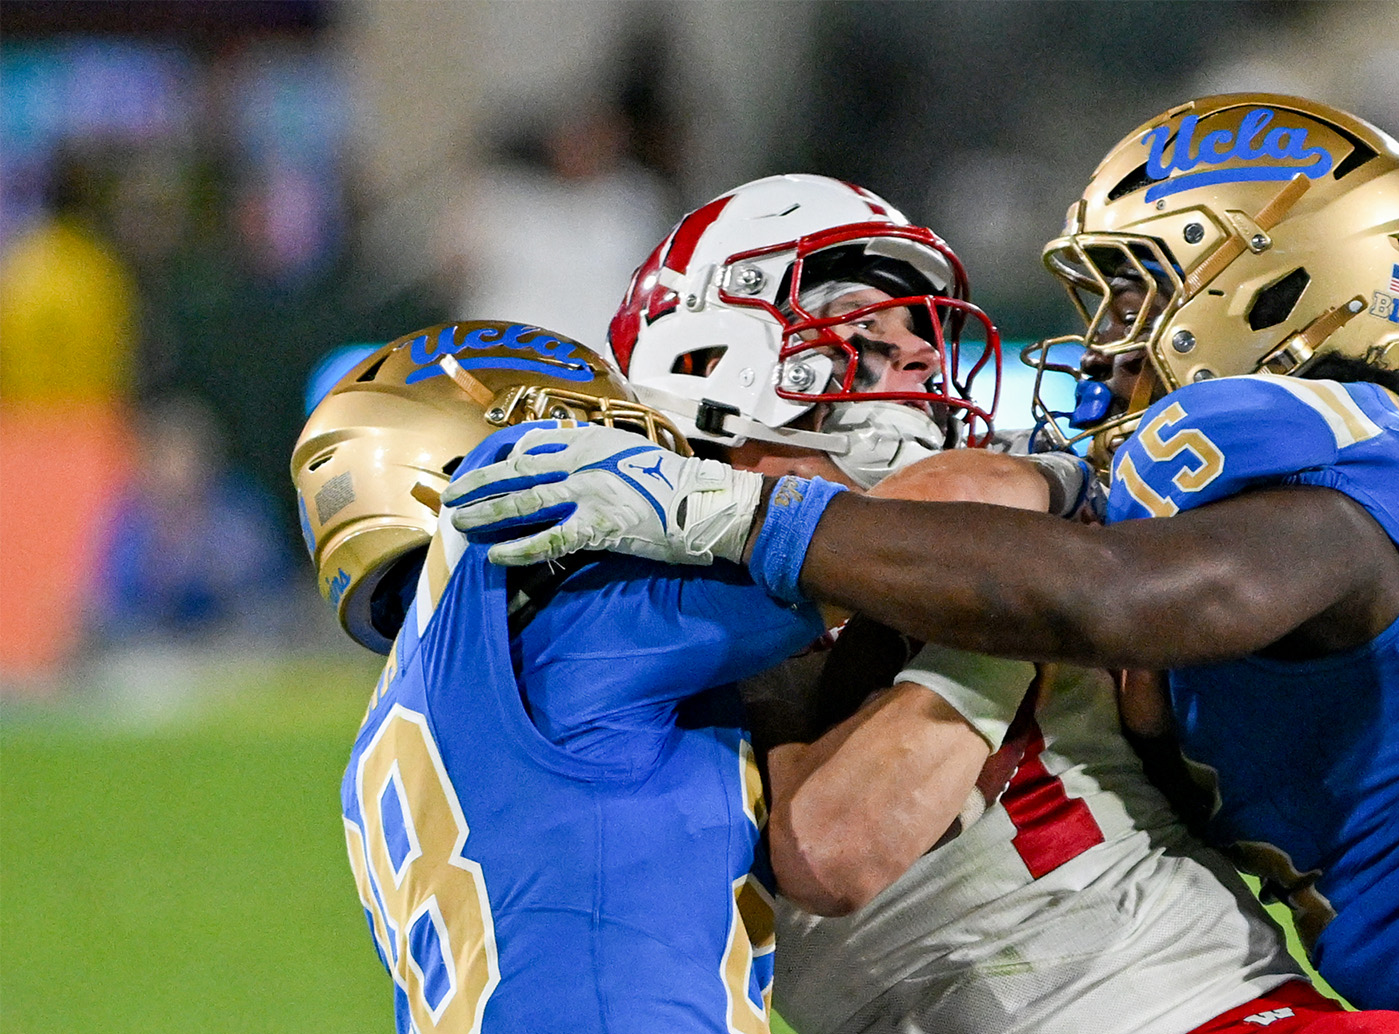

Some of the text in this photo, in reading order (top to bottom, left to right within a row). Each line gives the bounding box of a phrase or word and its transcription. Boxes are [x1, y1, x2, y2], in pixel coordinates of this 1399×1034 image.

[1141, 108, 1333, 204] Ucla
[405, 324, 595, 386] Ucla
[1116, 400, 1226, 518] 15
